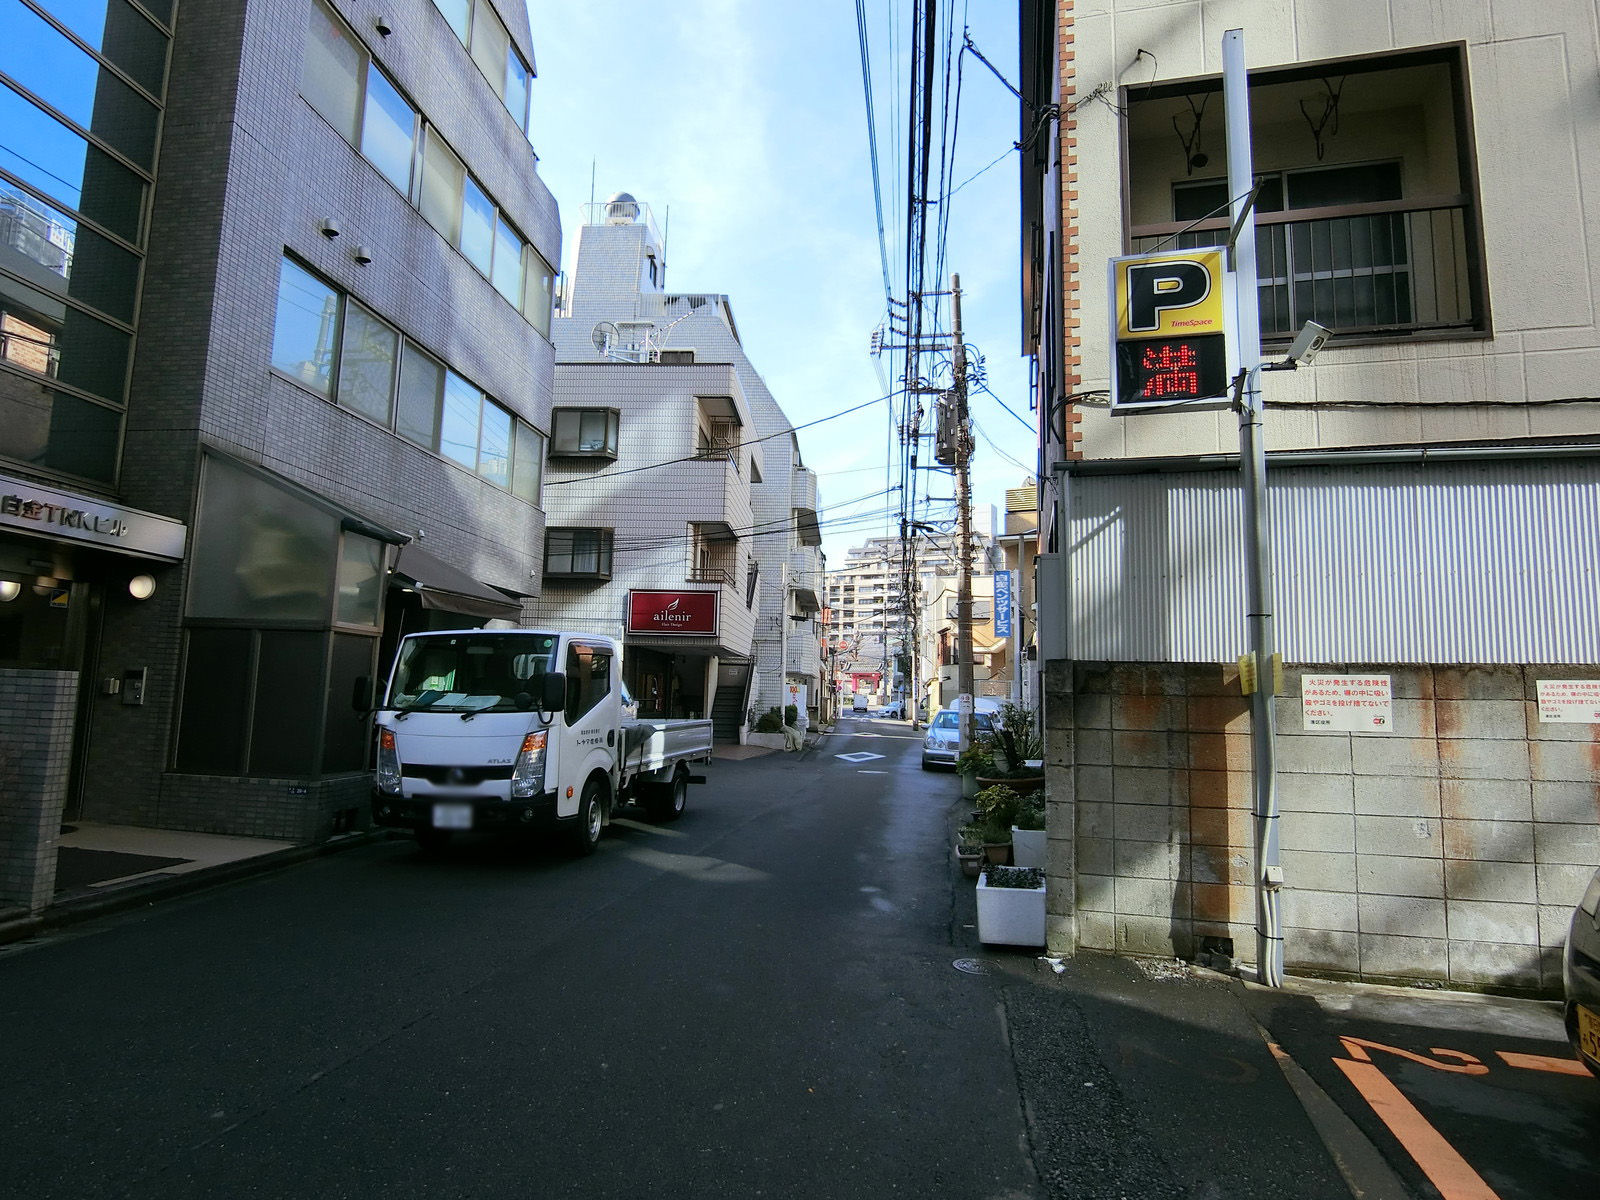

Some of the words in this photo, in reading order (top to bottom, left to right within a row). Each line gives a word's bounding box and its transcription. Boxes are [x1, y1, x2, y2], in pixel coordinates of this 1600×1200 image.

[1126, 259, 1211, 333] P
[1171, 318, 1213, 327] TimeSpace
[653, 609, 692, 621] ailenir
[1308, 679, 1388, 687] 火災が発生する危険性
